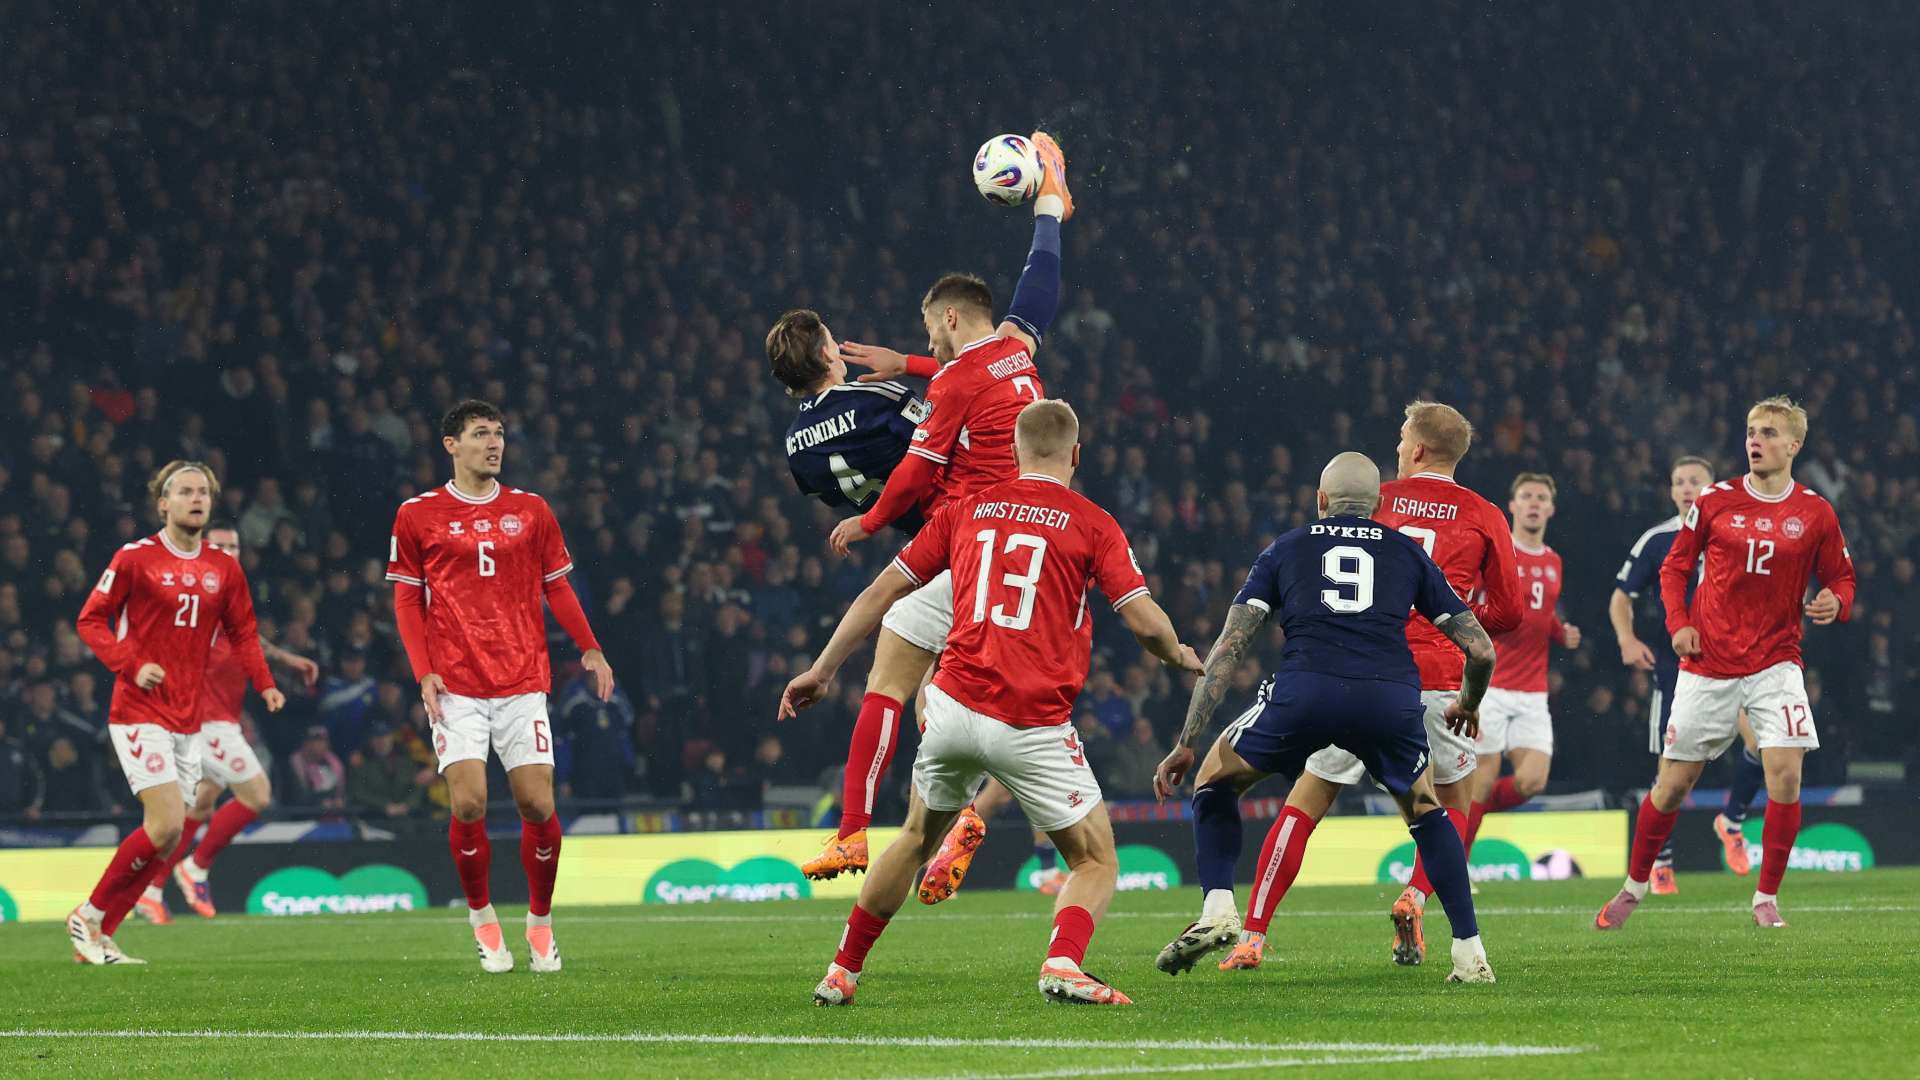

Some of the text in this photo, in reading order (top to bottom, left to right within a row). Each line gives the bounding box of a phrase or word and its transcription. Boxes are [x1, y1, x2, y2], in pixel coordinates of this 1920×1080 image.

[986, 350, 1033, 380] ANDERSE
[829, 452, 885, 506] 4
[973, 502, 1070, 531] KRISTENSEN
[1393, 497, 1458, 520] ISAKSEN
[1310, 524, 1383, 540] DYKES
[478, 541, 495, 577] 6
[1746, 538, 1775, 575] 12
[973, 529, 1047, 631] 13
[1320, 545, 1374, 614] 9
[1530, 581, 1544, 609] 9
[174, 592, 200, 629] 21
[533, 720, 549, 753] 6
[1781, 704, 1809, 737] 12
